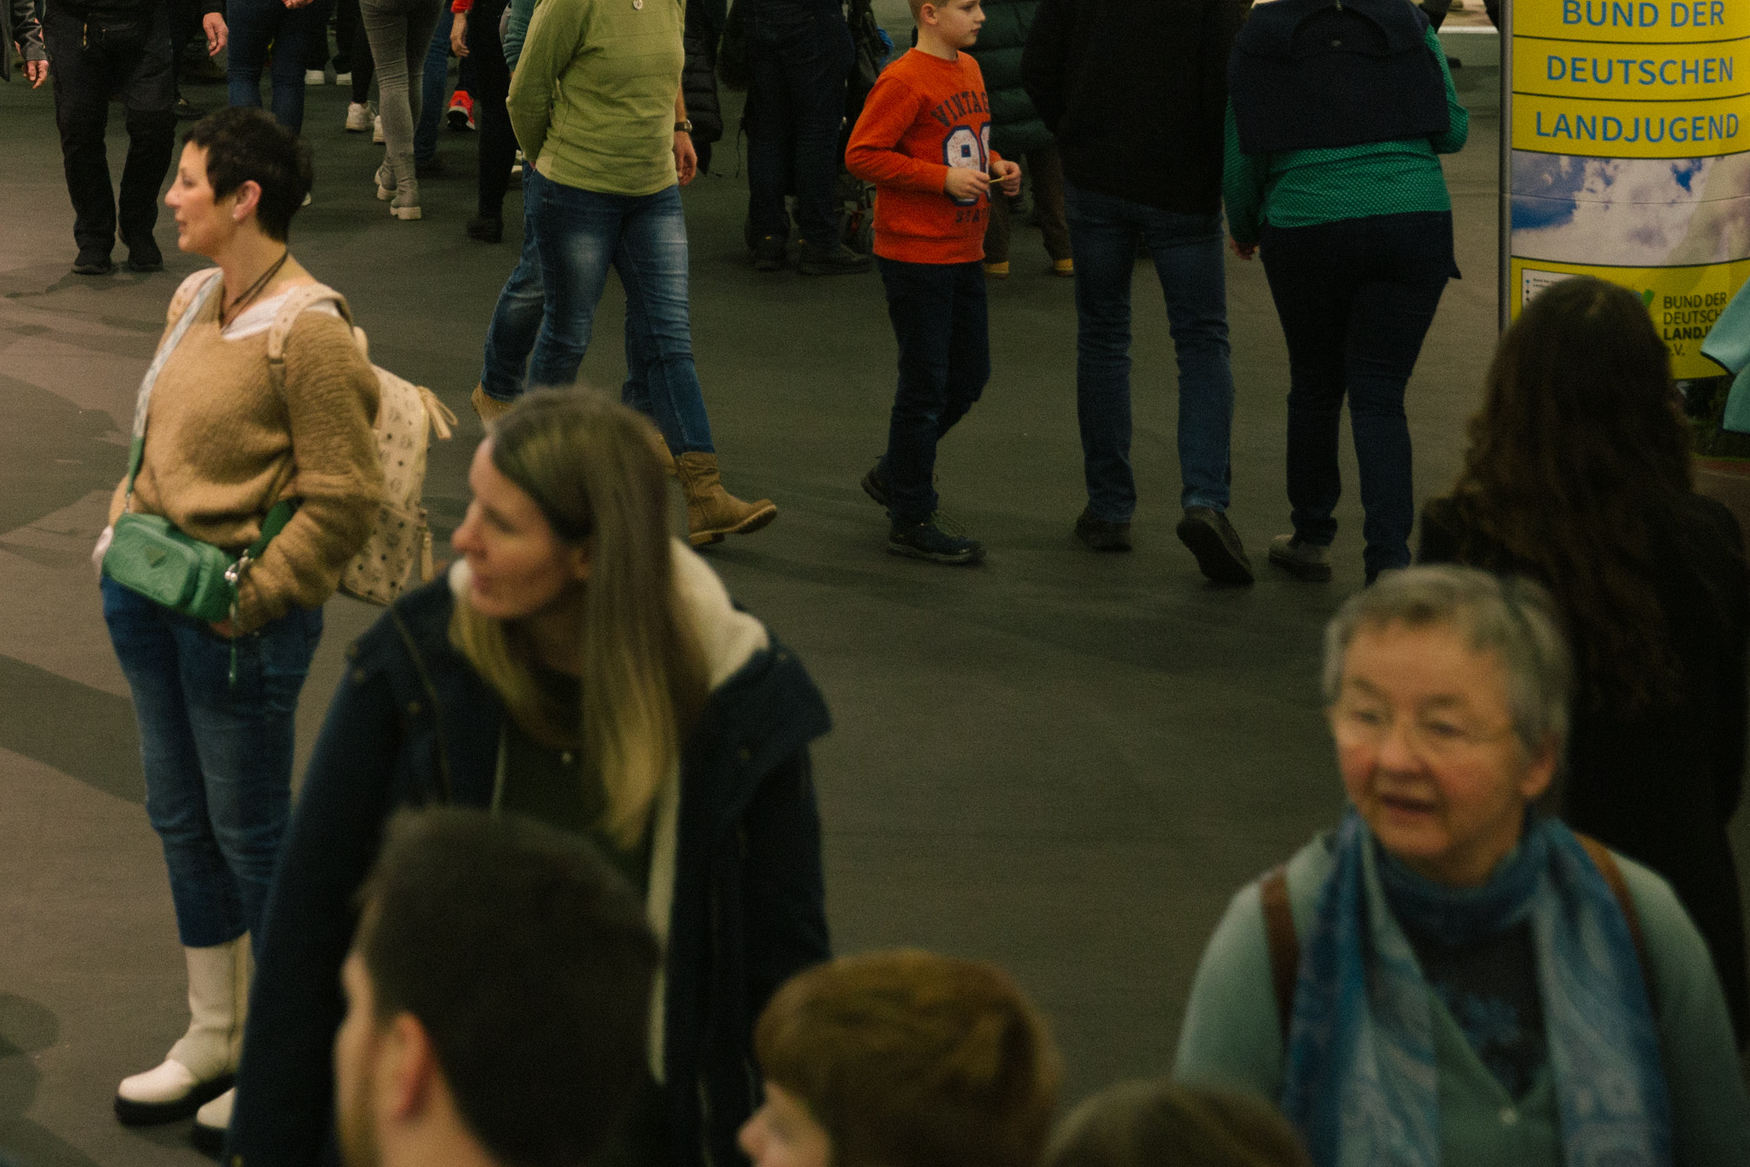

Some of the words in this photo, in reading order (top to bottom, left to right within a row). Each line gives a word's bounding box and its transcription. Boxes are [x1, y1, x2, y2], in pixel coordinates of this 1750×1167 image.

[1562, 0, 1659, 27] BUND
[1671, 0, 1725, 27] DER
[1547, 55, 1734, 85] DEUTSCHEN
[1536, 111, 1739, 143] LANDJUGEND
[1663, 294, 1703, 309] BUND
[1705, 292, 1727, 307] DER
